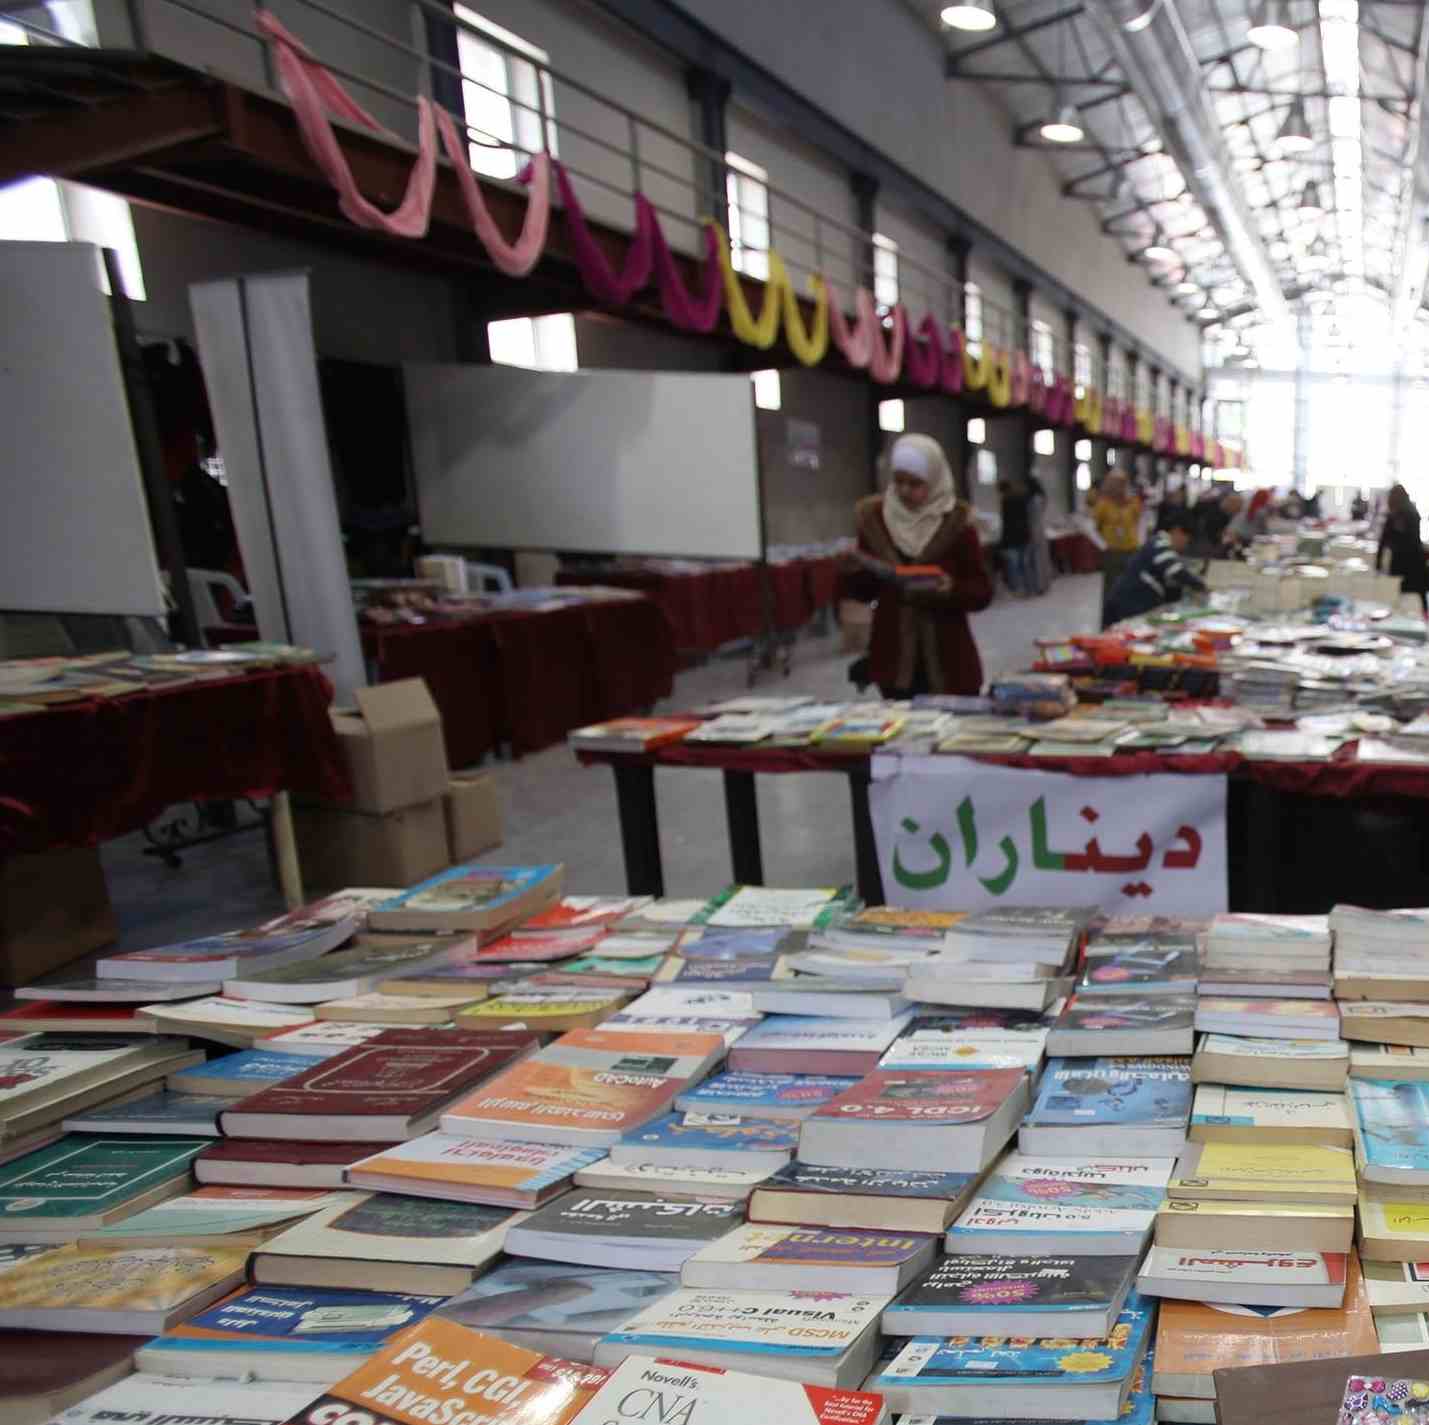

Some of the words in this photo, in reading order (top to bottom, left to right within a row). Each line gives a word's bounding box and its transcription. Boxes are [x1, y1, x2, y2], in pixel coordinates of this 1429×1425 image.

[893, 795, 1202, 898] ديناران
[593, 1071, 668, 1090] AutoCAD
[840, 1104, 895, 1115] 4.0
[906, 1104, 982, 1115] ICDL
[569, 1198, 735, 1216] الشبكات
[972, 1289, 1026, 1301] 50%
[762, 1307, 836, 1320] Visual
[787, 1328, 850, 1341] MCSD
[393, 1341, 471, 1391] Perl,
[463, 1368, 531, 1409] CGI,
[640, 1369, 699, 1390] Novell's
[360, 1374, 515, 1425] JavaScr
[616, 1387, 700, 1425] CNA
